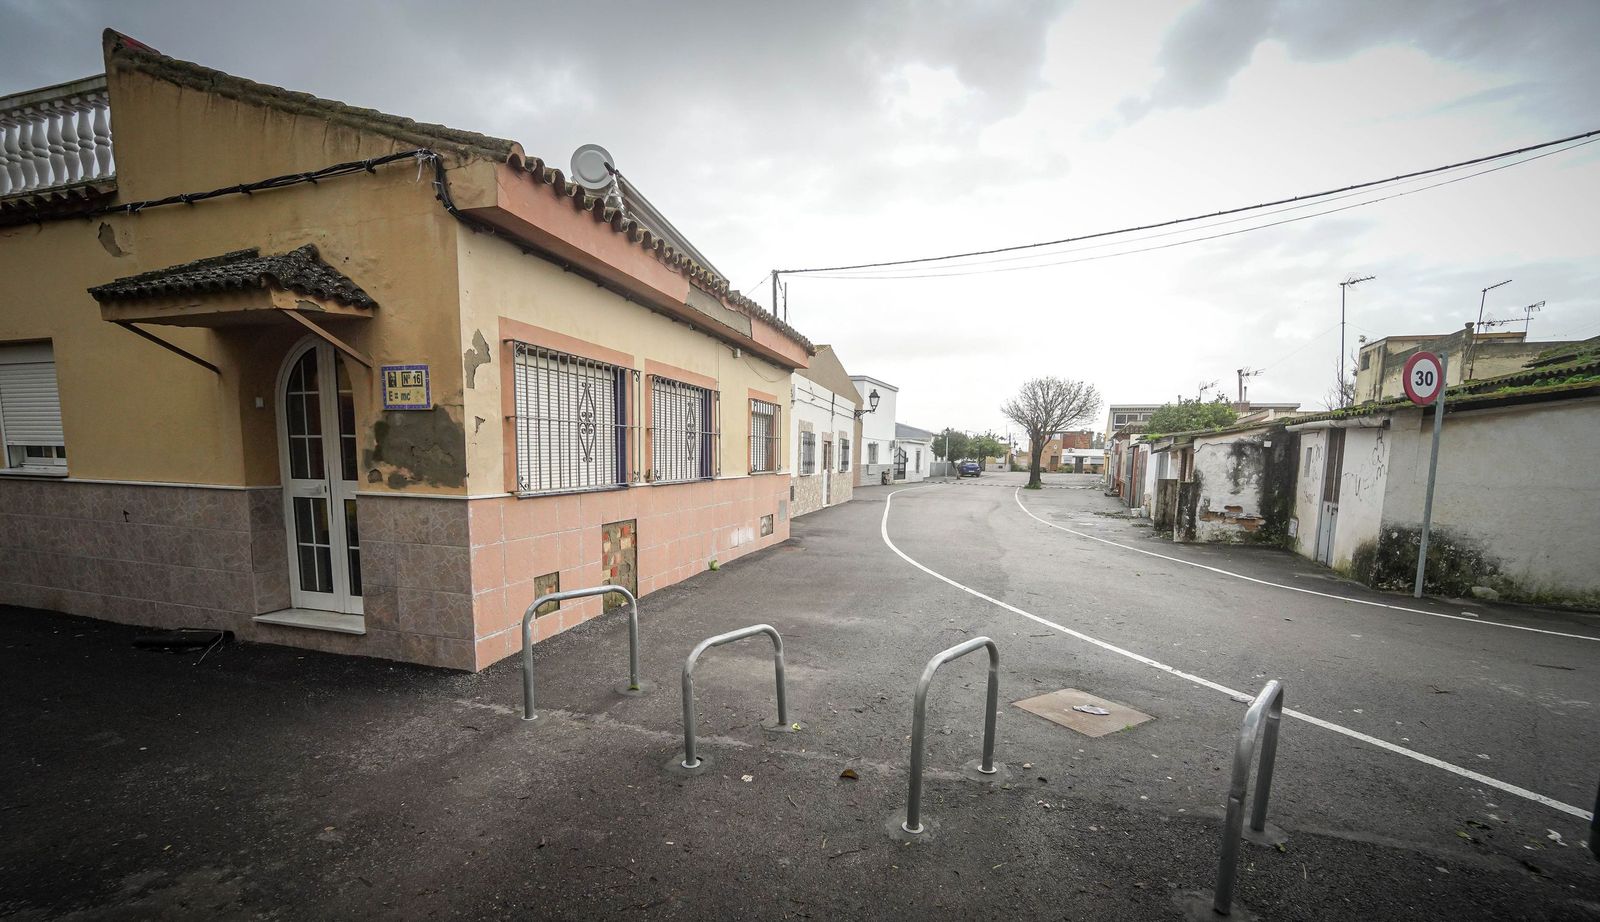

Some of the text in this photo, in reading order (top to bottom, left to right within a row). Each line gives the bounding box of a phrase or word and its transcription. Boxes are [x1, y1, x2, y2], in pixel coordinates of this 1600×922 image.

[413, 374, 421, 384] 16
[1415, 371, 1434, 387] 30
[388, 391, 393, 401] E
